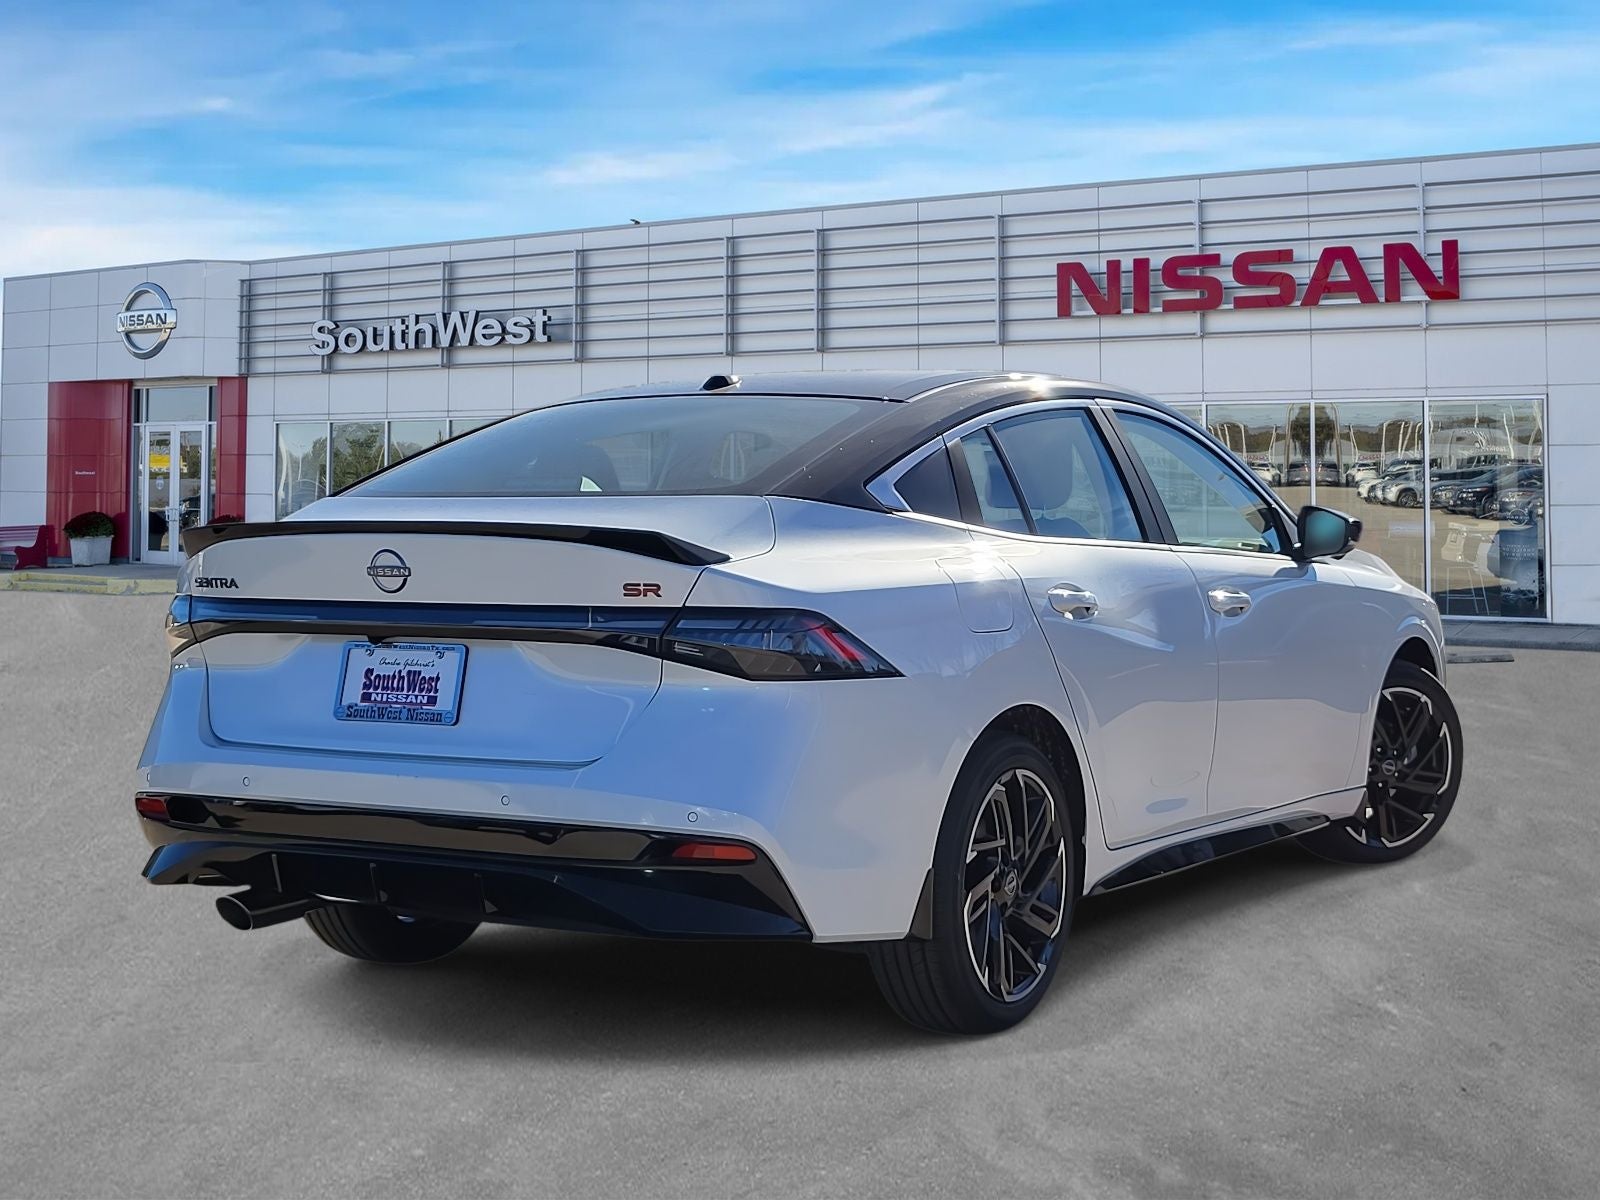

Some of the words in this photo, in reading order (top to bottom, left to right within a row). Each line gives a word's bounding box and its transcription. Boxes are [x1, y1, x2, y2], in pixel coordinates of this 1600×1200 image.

[1056, 239, 1460, 319] NISSAN
[119, 312, 168, 328] NISSAN
[309, 309, 552, 356] SouthWest
[367, 568, 410, 576] NISSAN
[194, 577, 240, 589] SENTRA
[622, 582, 663, 598] SR
[362, 668, 440, 693] SouthWest
[371, 693, 428, 703] NISSAN
[406, 707, 442, 722] Nissan
